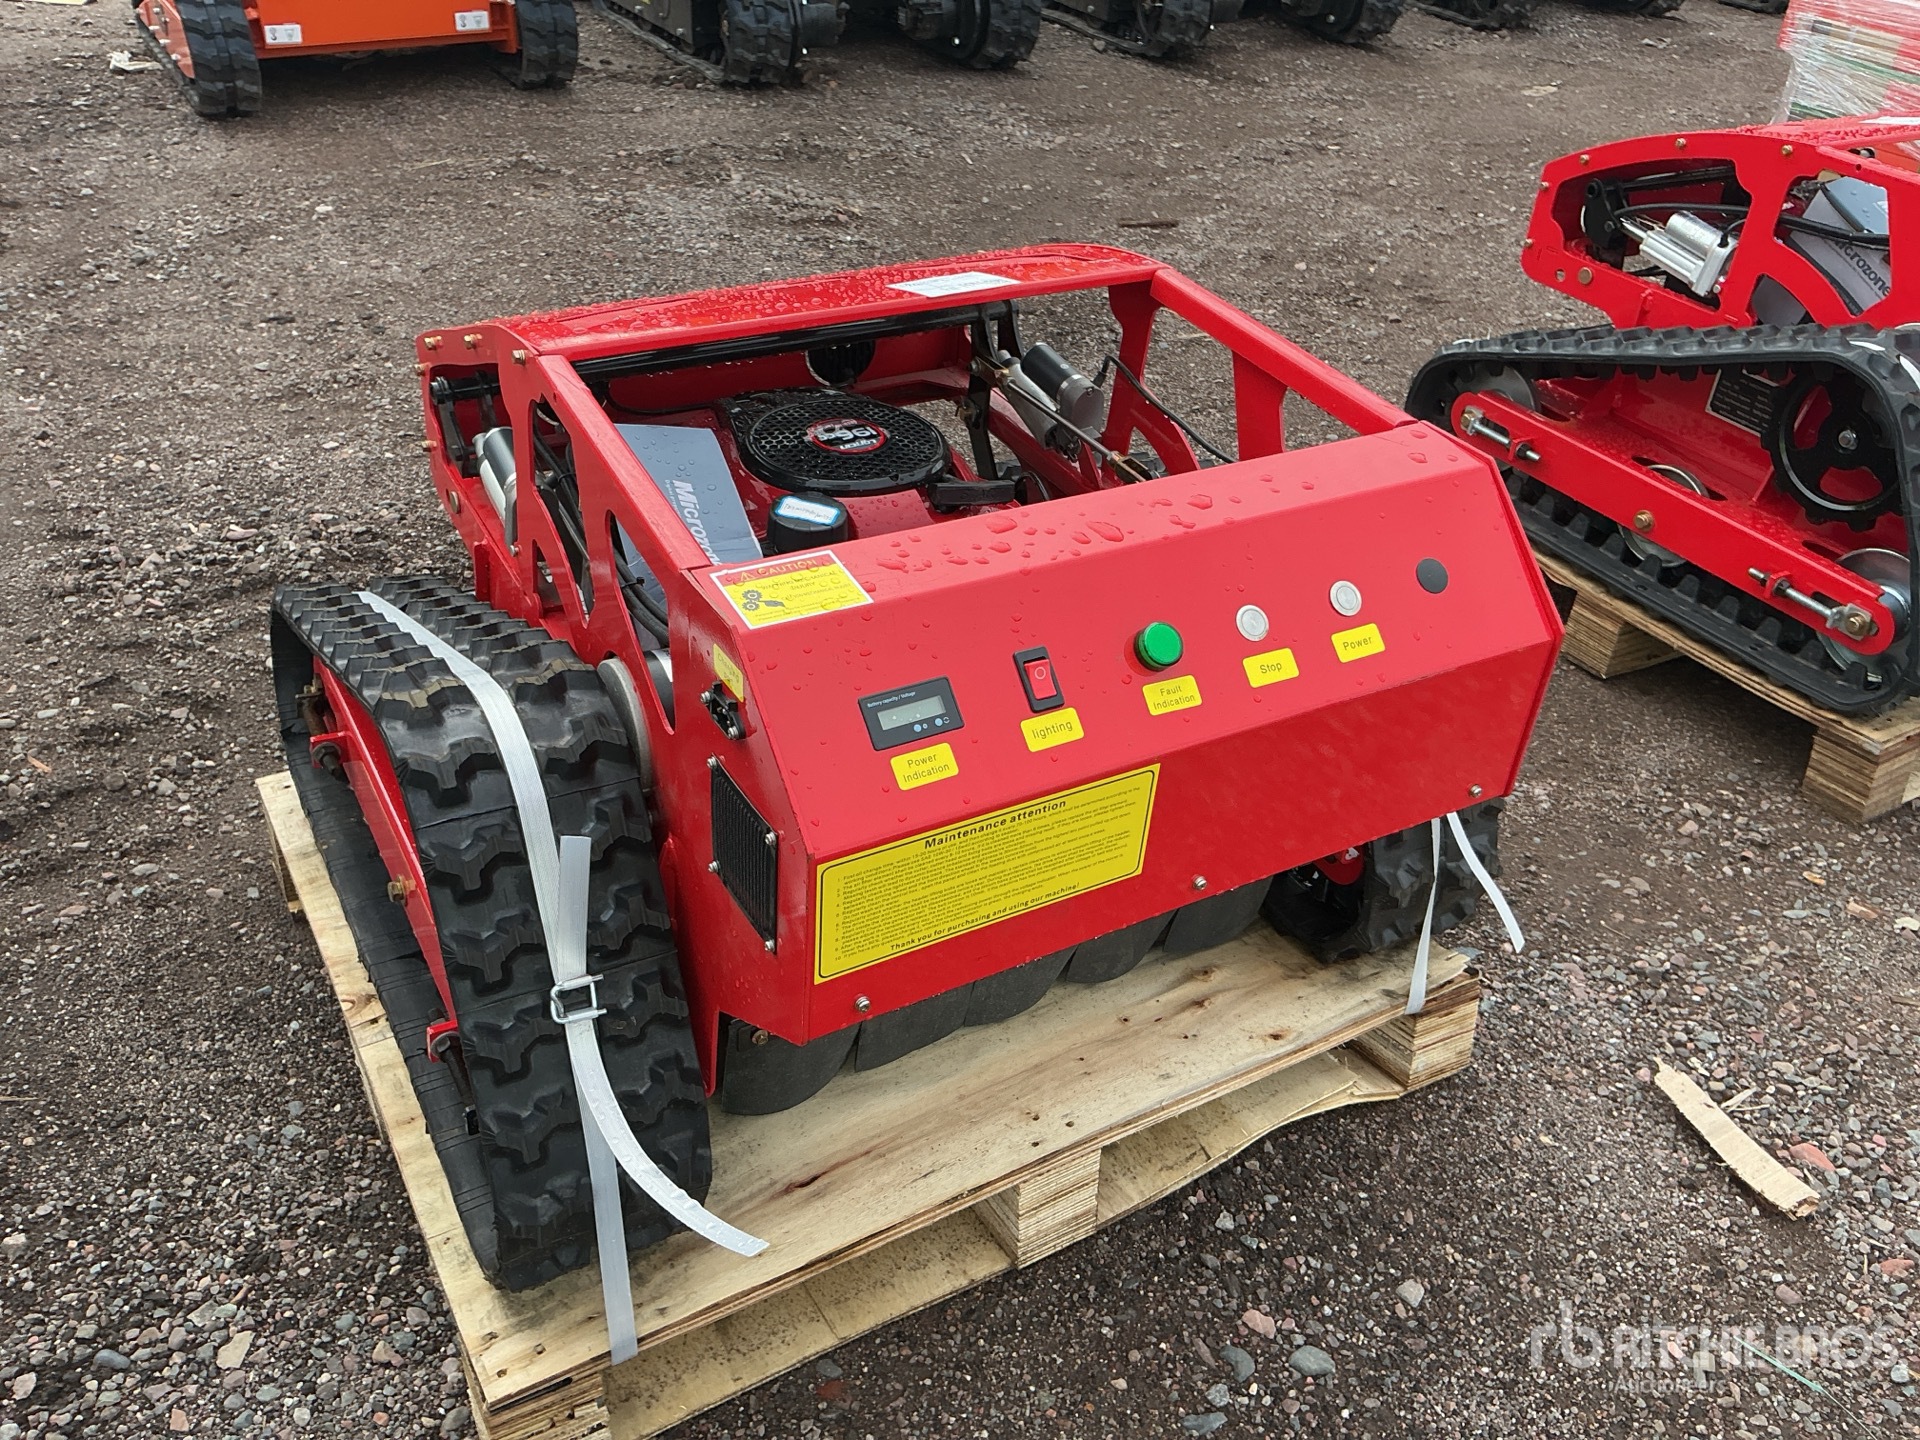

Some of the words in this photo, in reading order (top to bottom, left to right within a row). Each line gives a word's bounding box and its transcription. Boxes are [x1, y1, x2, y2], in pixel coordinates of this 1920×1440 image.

[758, 559, 817, 576] CAUTION
[1342, 635, 1372, 651] Power
[1260, 660, 1282, 674] Stop
[1160, 684, 1182, 697] Fault
[1152, 693, 1196, 710] Indication
[1032, 721, 1073, 740] lighting
[906, 754, 937, 768] Power
[902, 762, 950, 784] Indication
[924, 816, 1006, 849] Maintenance
[1009, 798, 1066, 823] attention
[890, 937, 915, 951] Thank
[917, 933, 931, 943] you
[934, 927, 945, 936] for
[947, 912, 990, 933] purchasing
[992, 906, 1006, 916] and
[1008, 899, 1028, 913] using
[1029, 895, 1043, 904] our
[1045, 881, 1079, 898] machine!
